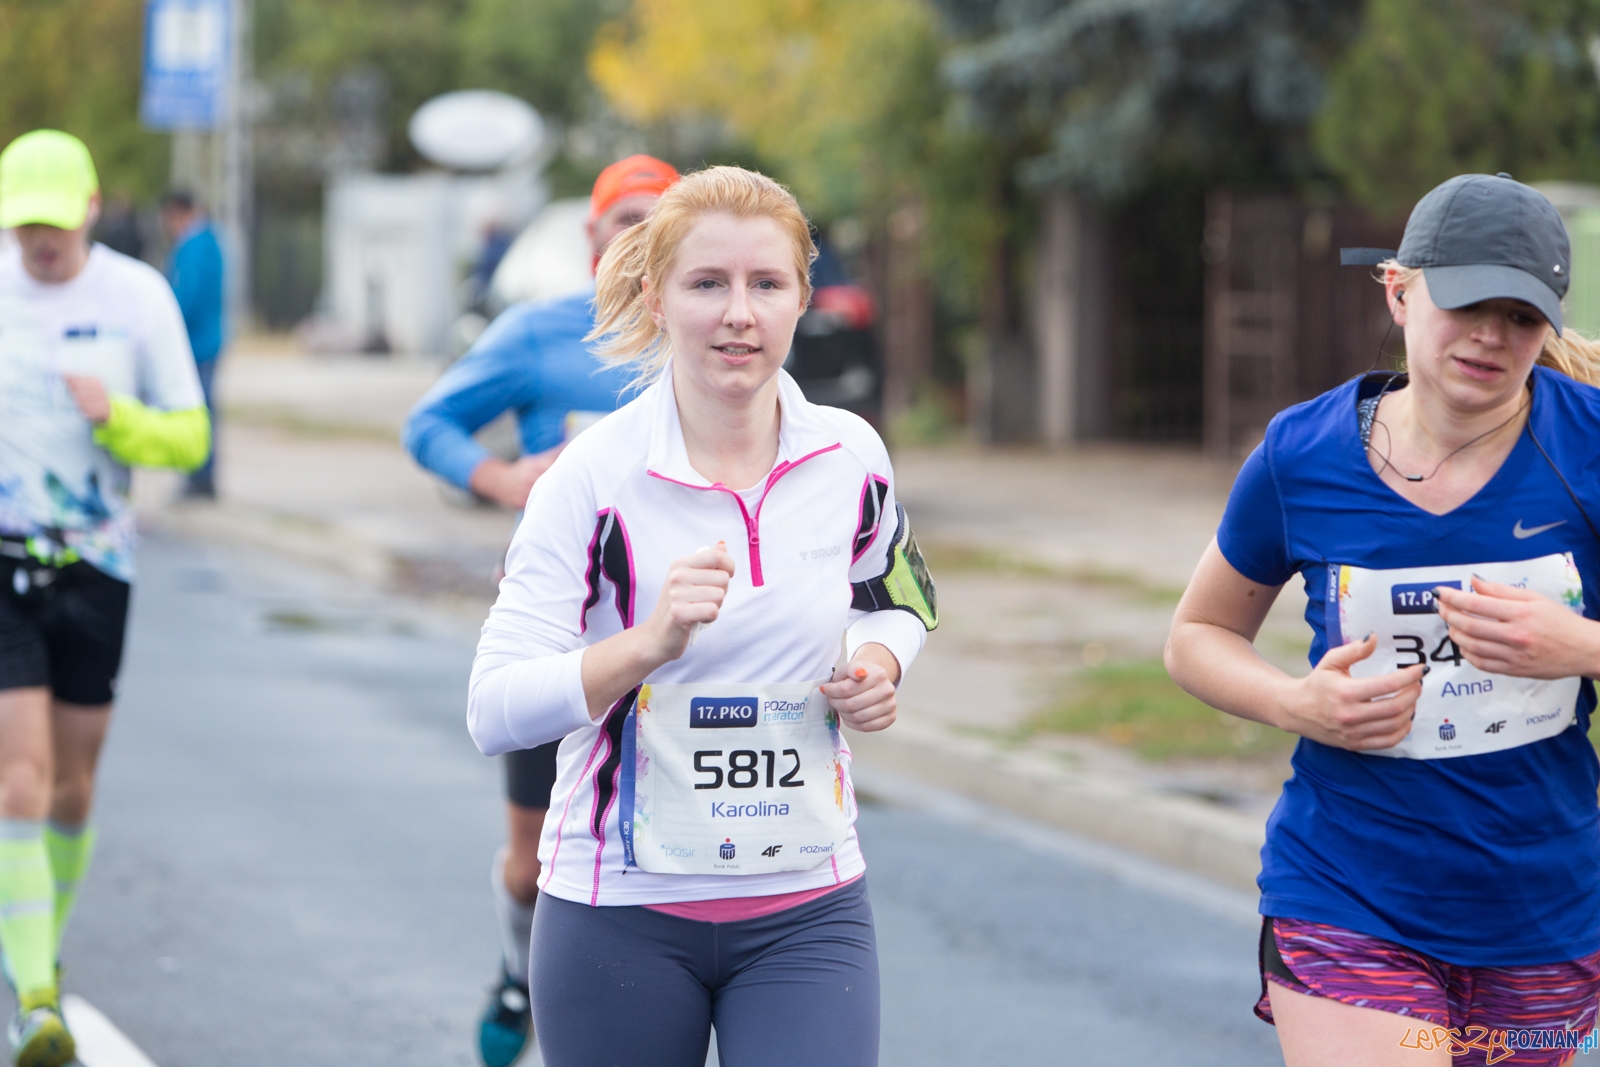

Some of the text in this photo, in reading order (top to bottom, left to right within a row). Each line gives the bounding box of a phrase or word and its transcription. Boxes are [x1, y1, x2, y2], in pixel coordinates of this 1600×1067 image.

[1397, 591, 1420, 606] 17.
[1393, 635, 1465, 669] 34
[1441, 679, 1493, 698] Anna
[697, 705, 752, 719] 17. PKO
[764, 711, 804, 722] maraton
[1485, 720, 1507, 734] 4F
[693, 748, 805, 790] 5812
[711, 801, 790, 818] Karolina
[761, 845, 783, 858] 4F
